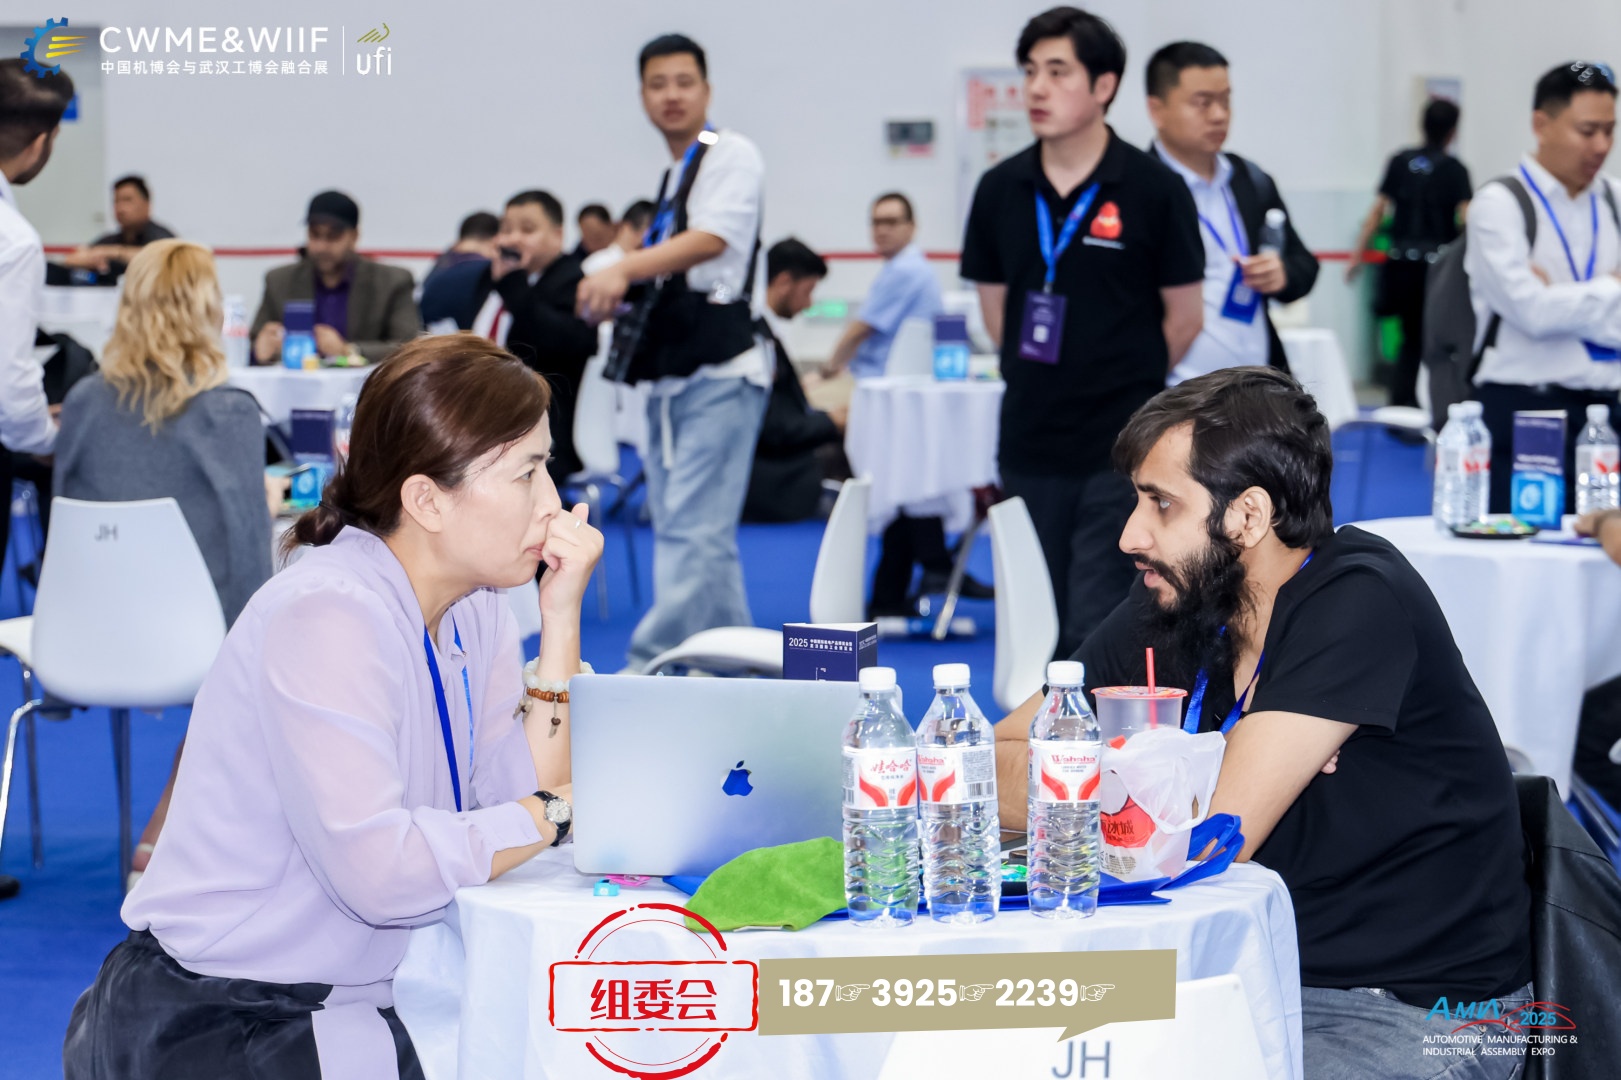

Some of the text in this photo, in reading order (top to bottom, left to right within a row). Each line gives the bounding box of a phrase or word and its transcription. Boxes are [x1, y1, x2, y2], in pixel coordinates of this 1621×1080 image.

[94, 523, 119, 543] JH
[788, 637, 809, 648] 2025
[1051, 754, 1096, 764] Wahaha
[1051, 1040, 1111, 1079] JH
